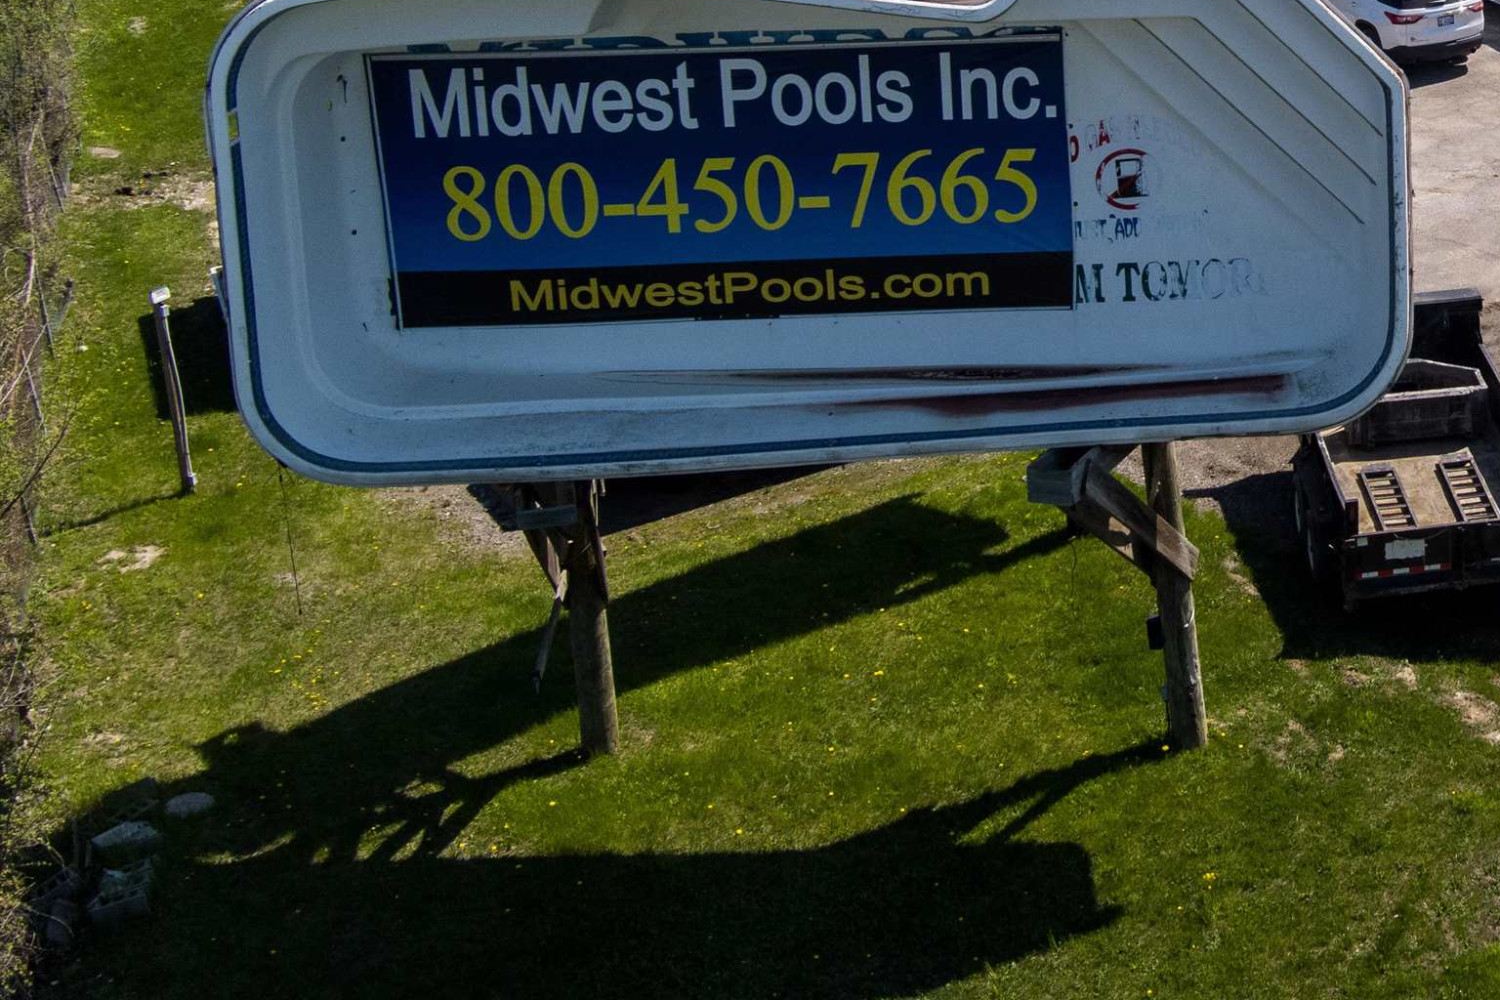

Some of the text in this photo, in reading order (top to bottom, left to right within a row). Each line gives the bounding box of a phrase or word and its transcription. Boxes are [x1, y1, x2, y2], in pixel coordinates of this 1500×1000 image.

[408, 51, 1057, 139] Midwest Pools Inc.
[442, 147, 1038, 242] 800-450-7665
[509, 268, 990, 312] MidwestPools.com
